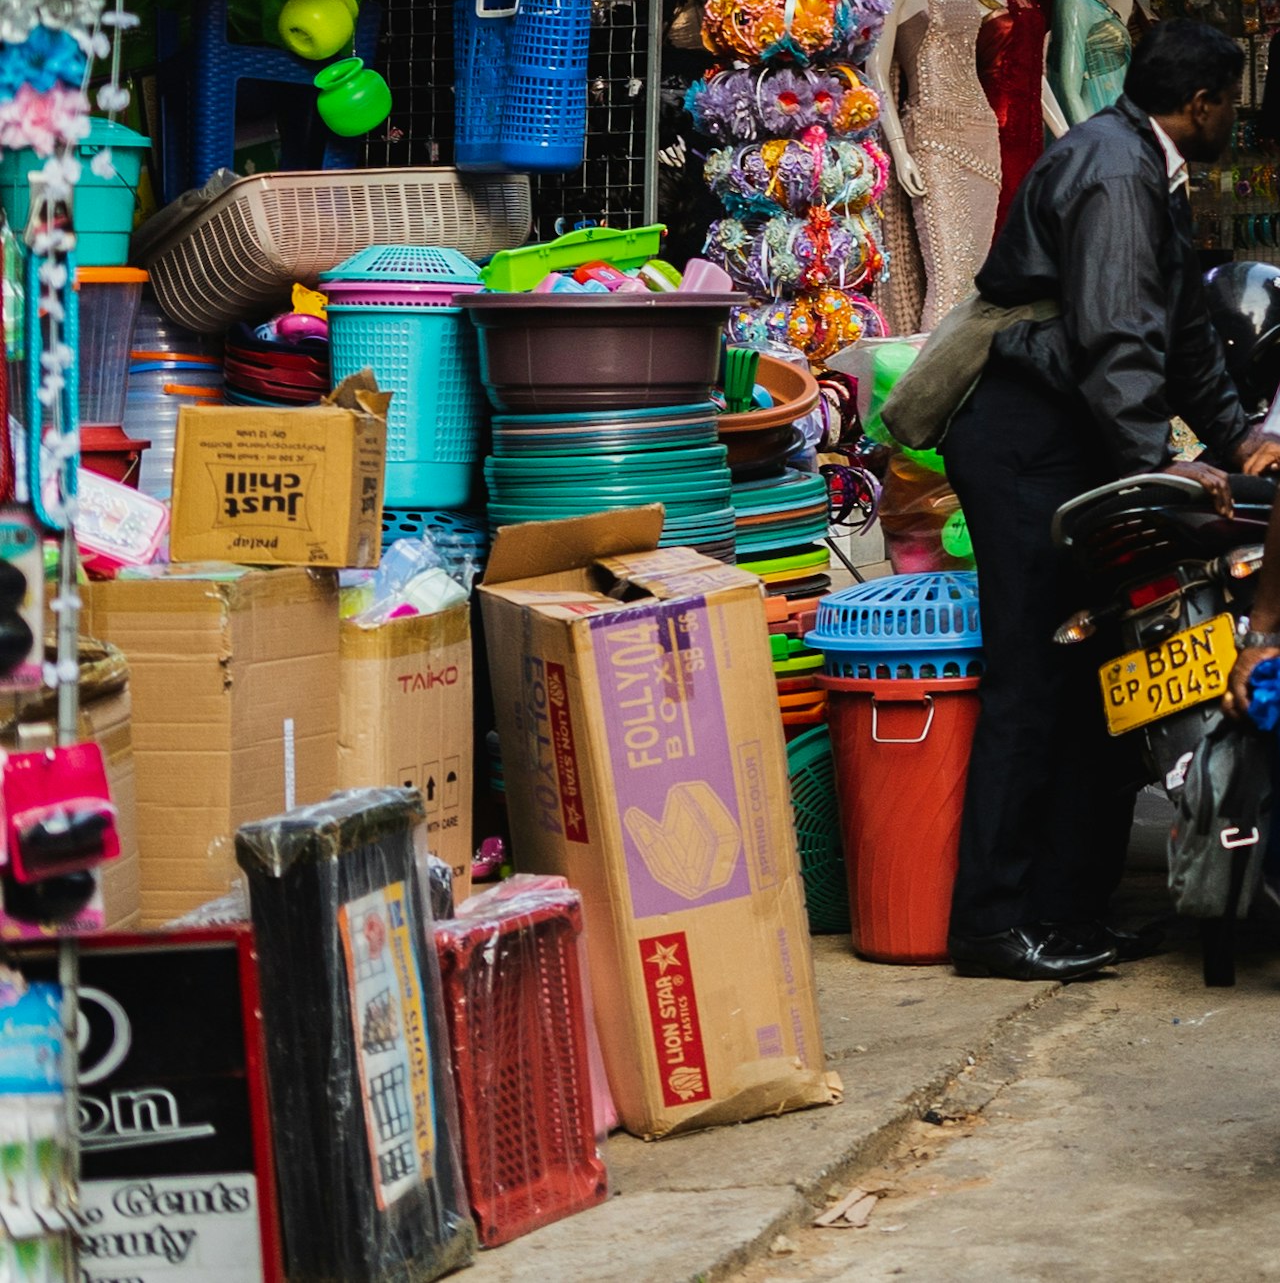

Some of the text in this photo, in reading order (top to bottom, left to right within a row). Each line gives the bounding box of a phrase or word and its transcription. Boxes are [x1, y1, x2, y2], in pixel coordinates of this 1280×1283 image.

[237, 442, 326, 453] Polypropylene
[226, 472, 301, 494] chill
[225, 492, 304, 522] just
[233, 535, 279, 549] pratap
[1144, 625, 1216, 680] BBN
[398, 664, 459, 694] TAIKO
[1110, 660, 1221, 714] CP 9045
[443, 815, 459, 830] CARE
[746, 755, 771, 878] COLOR SPRING
[654, 974, 685, 1066] STAR LION
[676, 995, 695, 1042] PLASTICS
[113, 1181, 250, 1219] Gents
